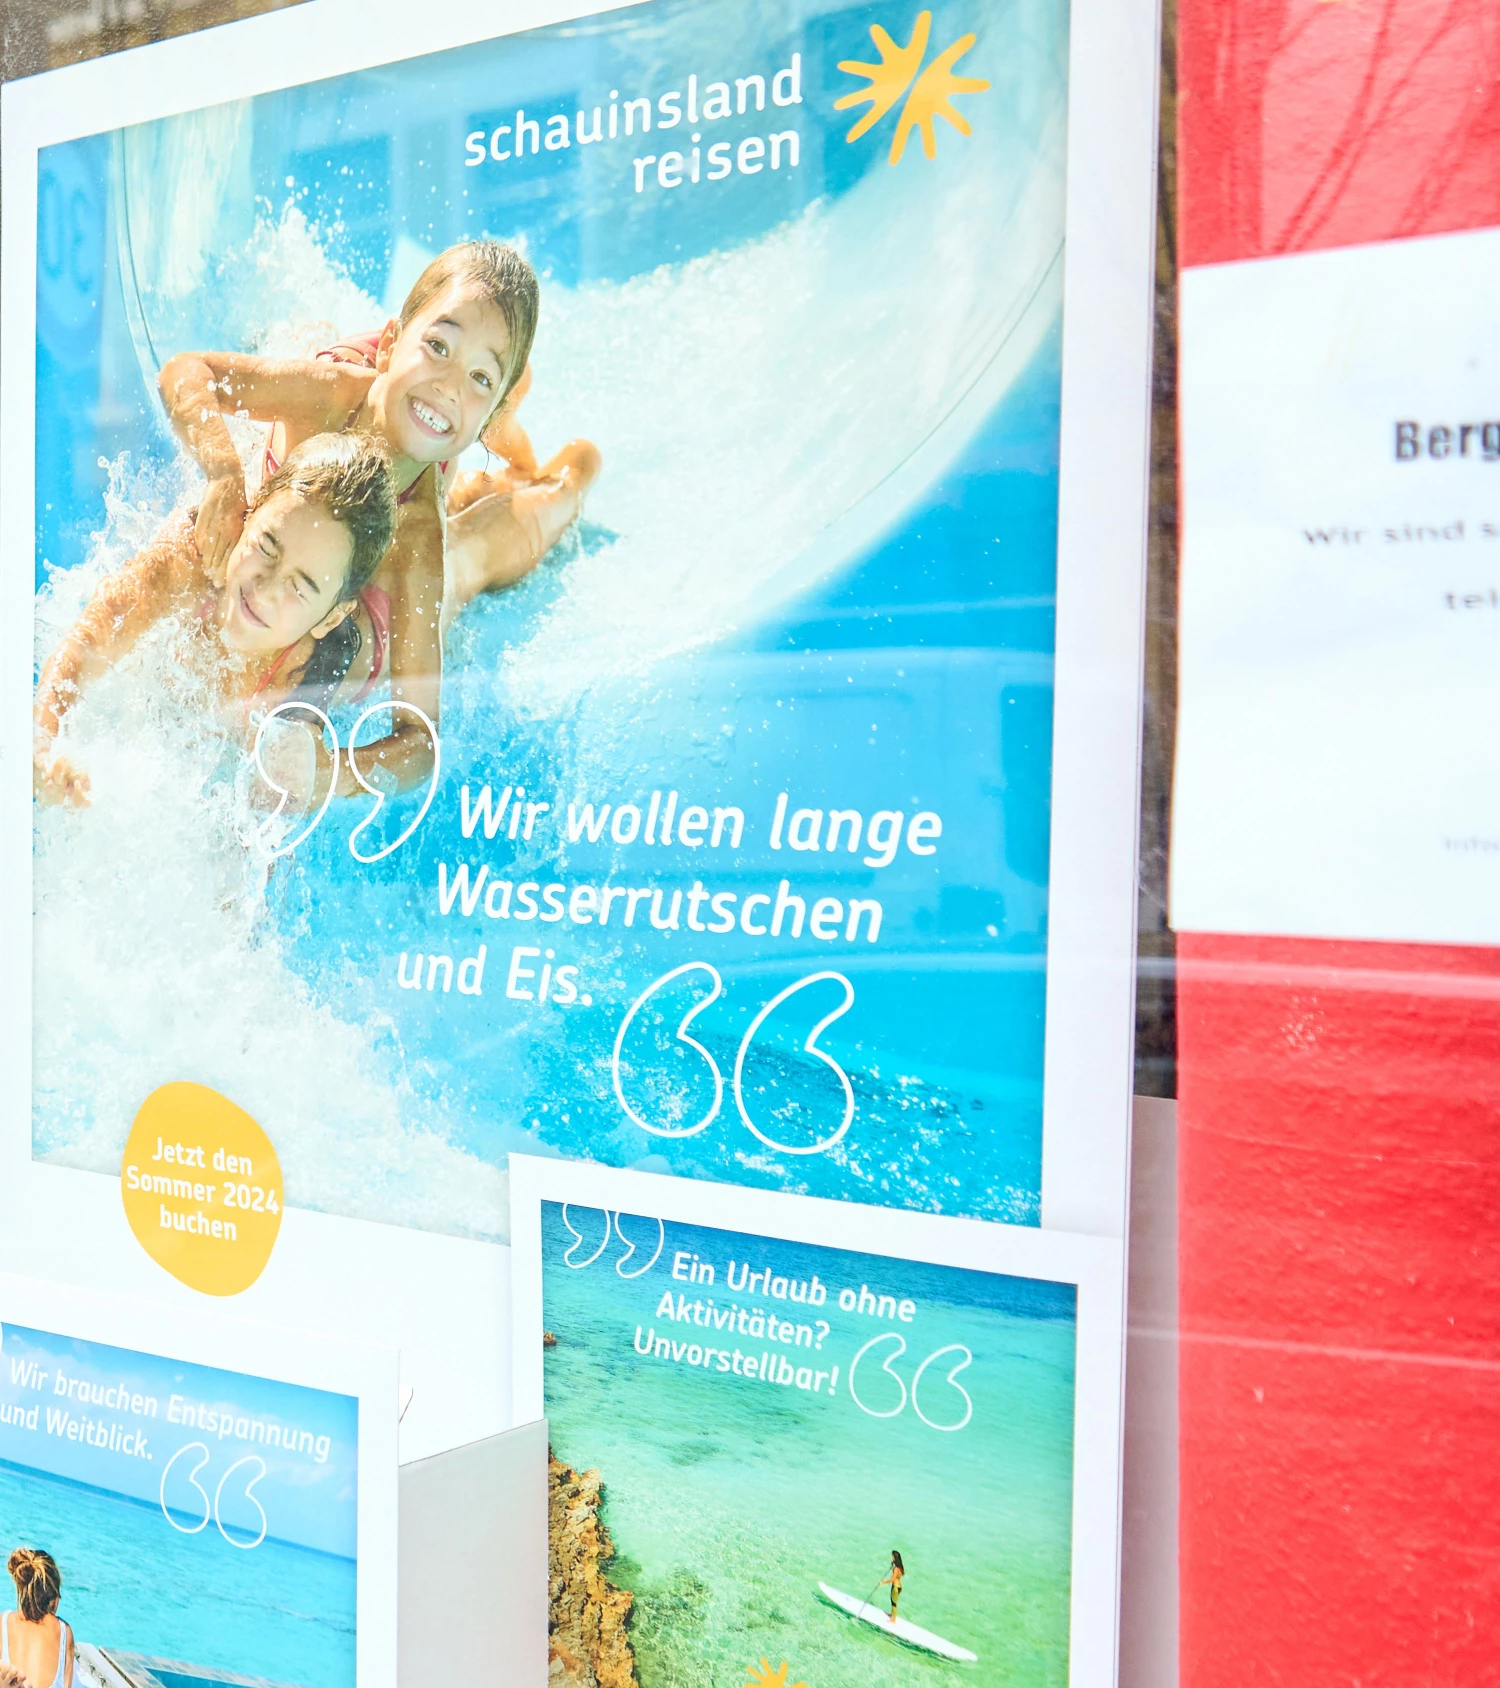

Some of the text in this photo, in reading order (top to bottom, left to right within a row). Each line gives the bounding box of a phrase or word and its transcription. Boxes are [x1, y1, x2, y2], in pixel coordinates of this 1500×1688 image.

[463, 52, 802, 167] schauinsland
[633, 130, 801, 193] reisen
[1303, 526, 1362, 545] Wir
[1384, 519, 1465, 541] sind
[459, 784, 943, 868] Wir wollen lange
[437, 861, 884, 944] Wasserrutschen
[397, 944, 593, 1007] und Eis.
[151, 1136, 253, 1177] Jetzt den
[126, 1165, 280, 1215] Sommer 2024
[159, 1203, 237, 1241] buchen
[671, 1250, 916, 1323] Ein Urlaub ohne
[655, 1290, 830, 1351] Aktivitäten?
[633, 1325, 839, 1396] Unvorstellbar!
[0, 1402, 153, 1461] und Weitblick.
[10, 1356, 331, 1464] Wir brauchen Entspannung
